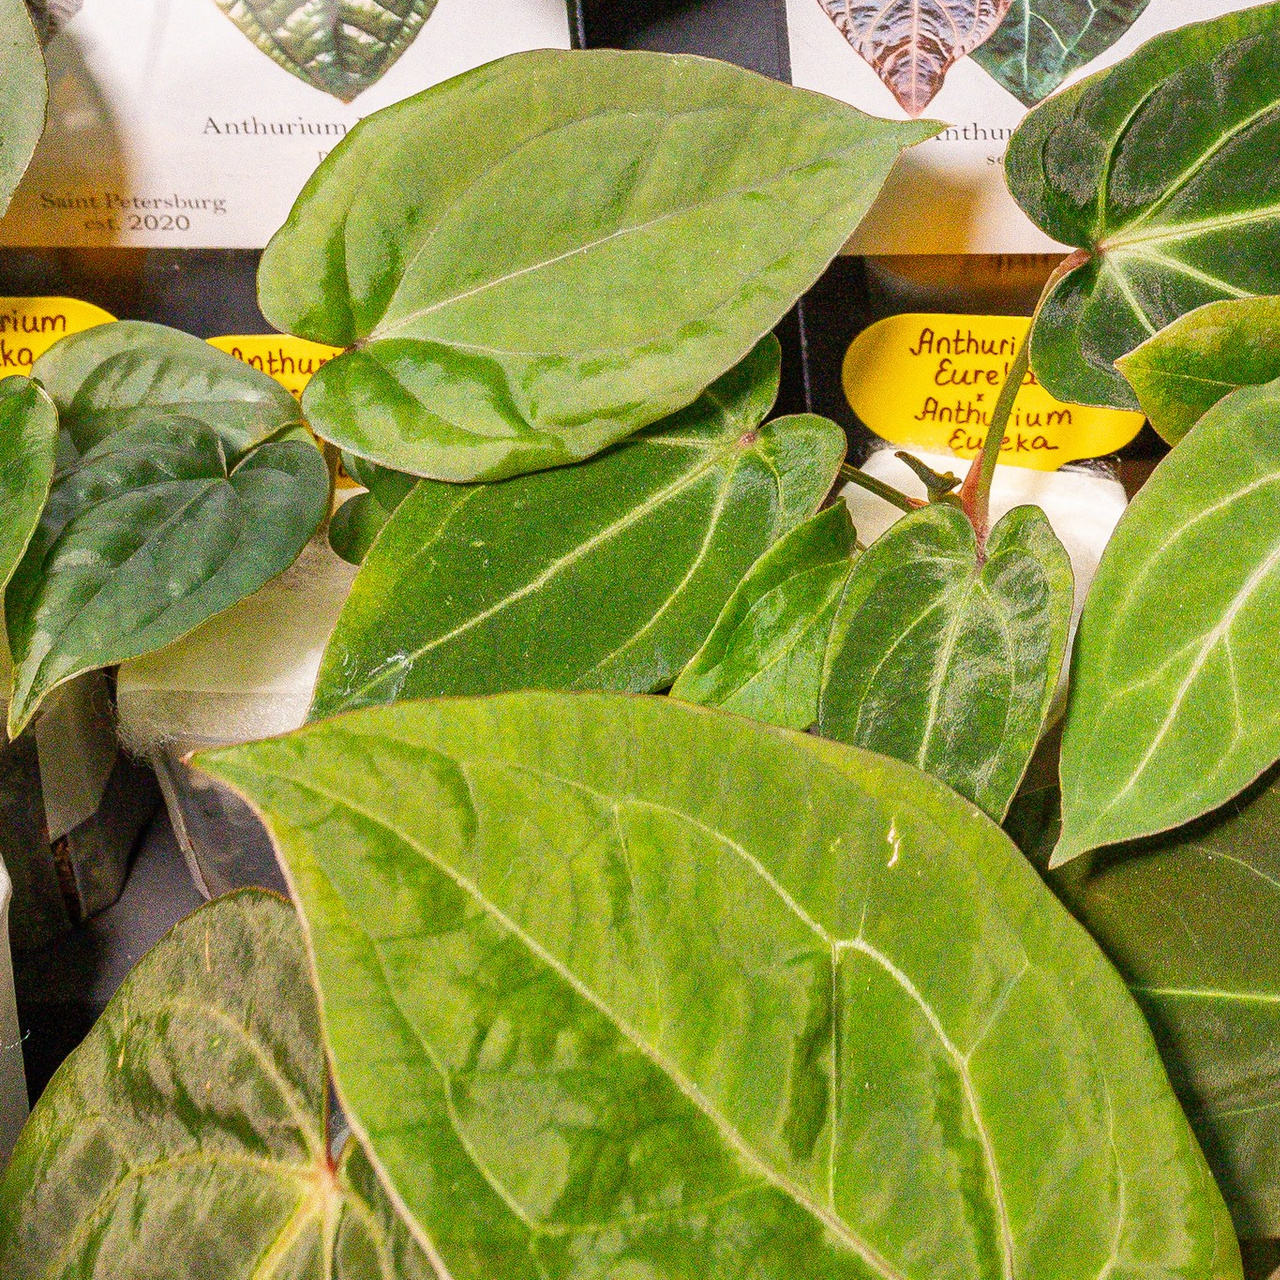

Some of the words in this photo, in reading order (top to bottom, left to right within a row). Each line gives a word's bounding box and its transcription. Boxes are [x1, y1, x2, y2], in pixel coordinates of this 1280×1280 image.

[202, 116, 348, 136] Anthurium
[103, 192, 227, 214] Petersburg
[129, 214, 191, 232] 2020
[949, 428, 1060, 452] Eueka
